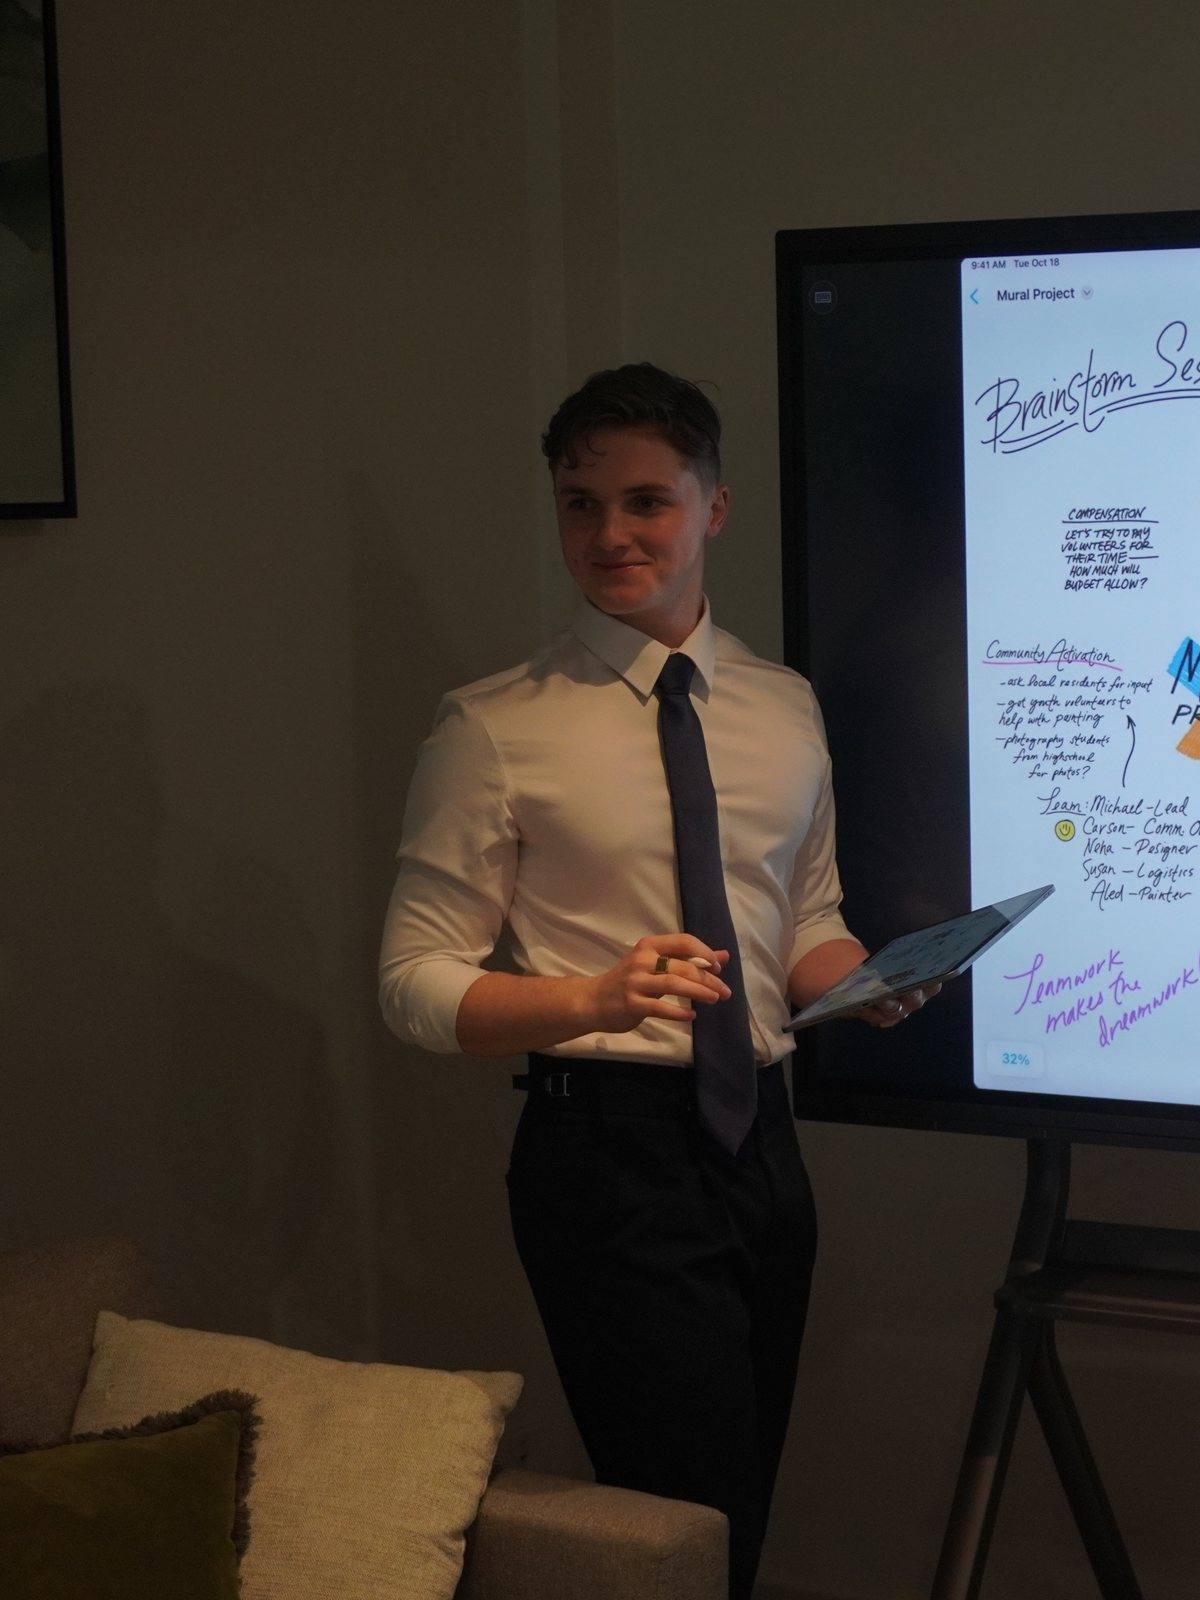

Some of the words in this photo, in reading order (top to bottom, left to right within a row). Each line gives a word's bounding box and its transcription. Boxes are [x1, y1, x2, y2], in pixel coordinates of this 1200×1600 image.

[972, 261, 990, 269] 9:41
[992, 260, 1006, 268] AM
[1014, 260, 1029, 268] Tue
[1032, 259, 1046, 267] Oct
[1050, 258, 1060, 266] 18
[997, 289, 1030, 301] Mural
[1033, 288, 1075, 301] Project
[976, 349, 1136, 453] Brainstorm
[1069, 507, 1146, 520] COMPENSATION
[1066, 528, 1091, 540] LET'S
[1094, 528, 1115, 539] TRY
[1116, 529, 1130, 538] TO
[1132, 527, 1150, 540] PAY
[1061, 540, 1126, 552] VOLUNTEERS
[1130, 541, 1154, 550] FOR
[1066, 553, 1096, 564] THEIR
[1098, 552, 1127, 564] TIME
[1070, 565, 1092, 578] HOW
[1092, 565, 1119, 576] MUCH
[1121, 564, 1140, 575] WILL
[1064, 579, 1104, 591] BUDGET
[1104, 577, 1148, 591] ALLOW?
[986, 639, 1045, 663] Community
[1045, 639, 1115, 671] Activation
[1029, 674, 1056, 687] local
[1060, 676, 1107, 692] residents
[1108, 676, 1124, 692] for
[1128, 679, 1153, 694] input
[1028, 764, 1048, 778] for
[1052, 765, 1091, 781] photos?
[1037, 787, 1088, 815] Team:
[1090, 795, 1143, 816] Michael
[1143, 818, 1185, 835] Comm.
[1084, 838, 1114, 856] Neha
[1135, 839, 1198, 861] Designer
[1083, 859, 1116, 881] Susan
[1137, 863, 1194, 886] Logistics
[1090, 880, 1124, 909] Aled
[1003, 950, 1123, 1015] Teamwork
[1046, 991, 1103, 1034] makes
[1109, 971, 1141, 1005] the
[1002, 1052, 1031, 1066] 32%
